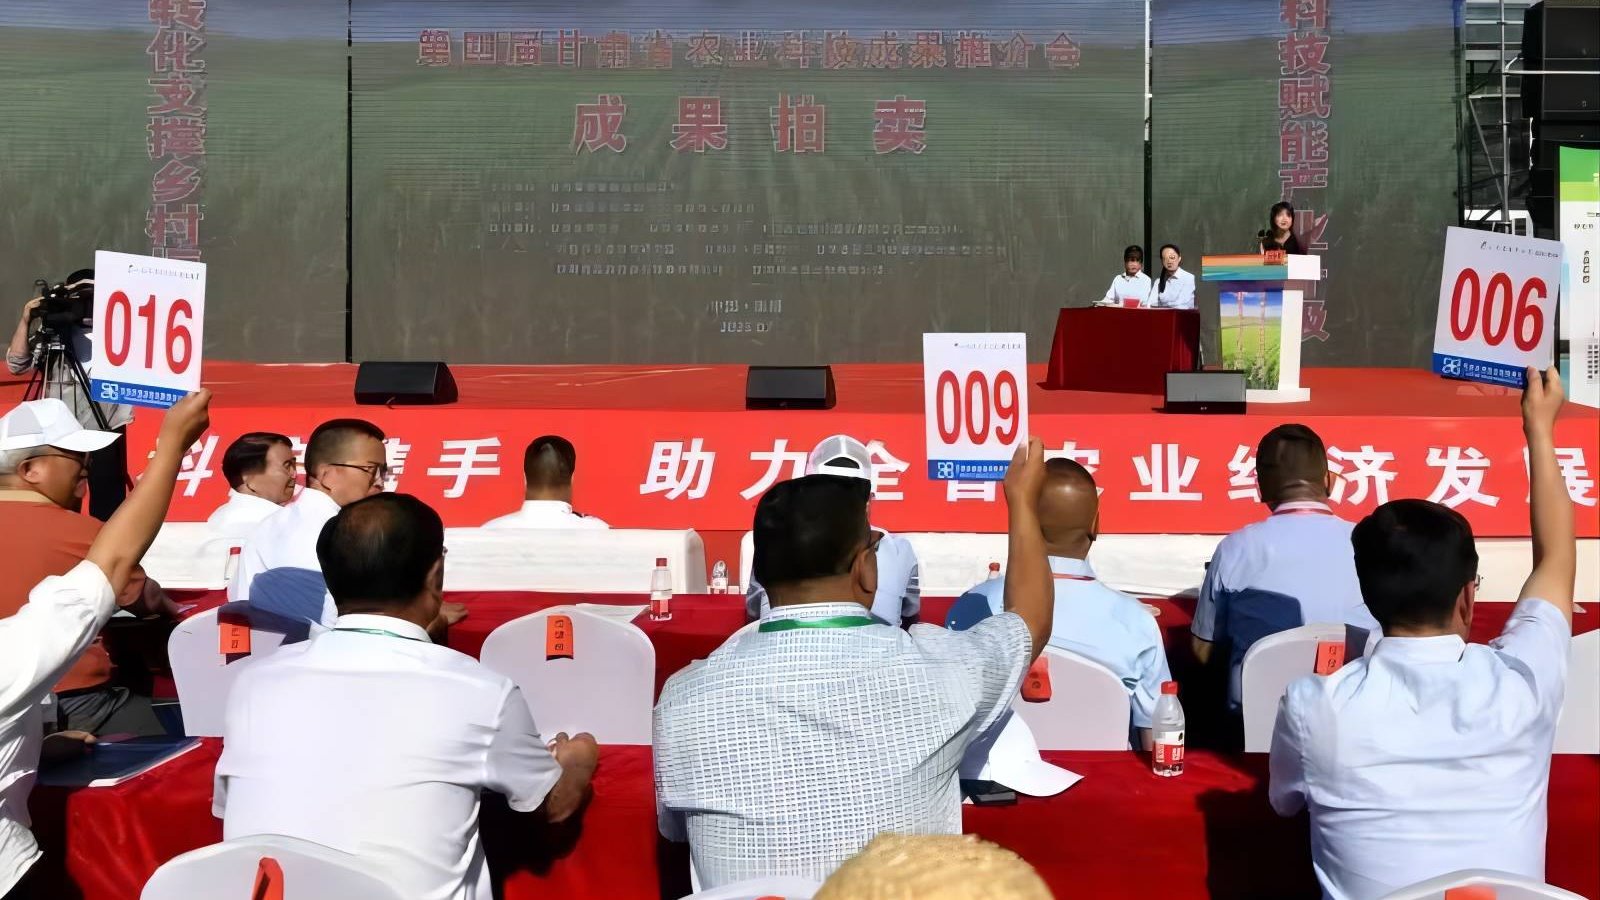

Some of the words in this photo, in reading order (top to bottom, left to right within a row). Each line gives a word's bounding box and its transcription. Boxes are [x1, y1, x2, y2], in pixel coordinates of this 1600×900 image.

[145, 0, 206, 262] 转化支撑乡村
[571, 94, 930, 155] 成果拍卖
[104, 290, 193, 375] 016
[1450, 267, 1547, 353] 006
[936, 369, 1020, 446] 009
